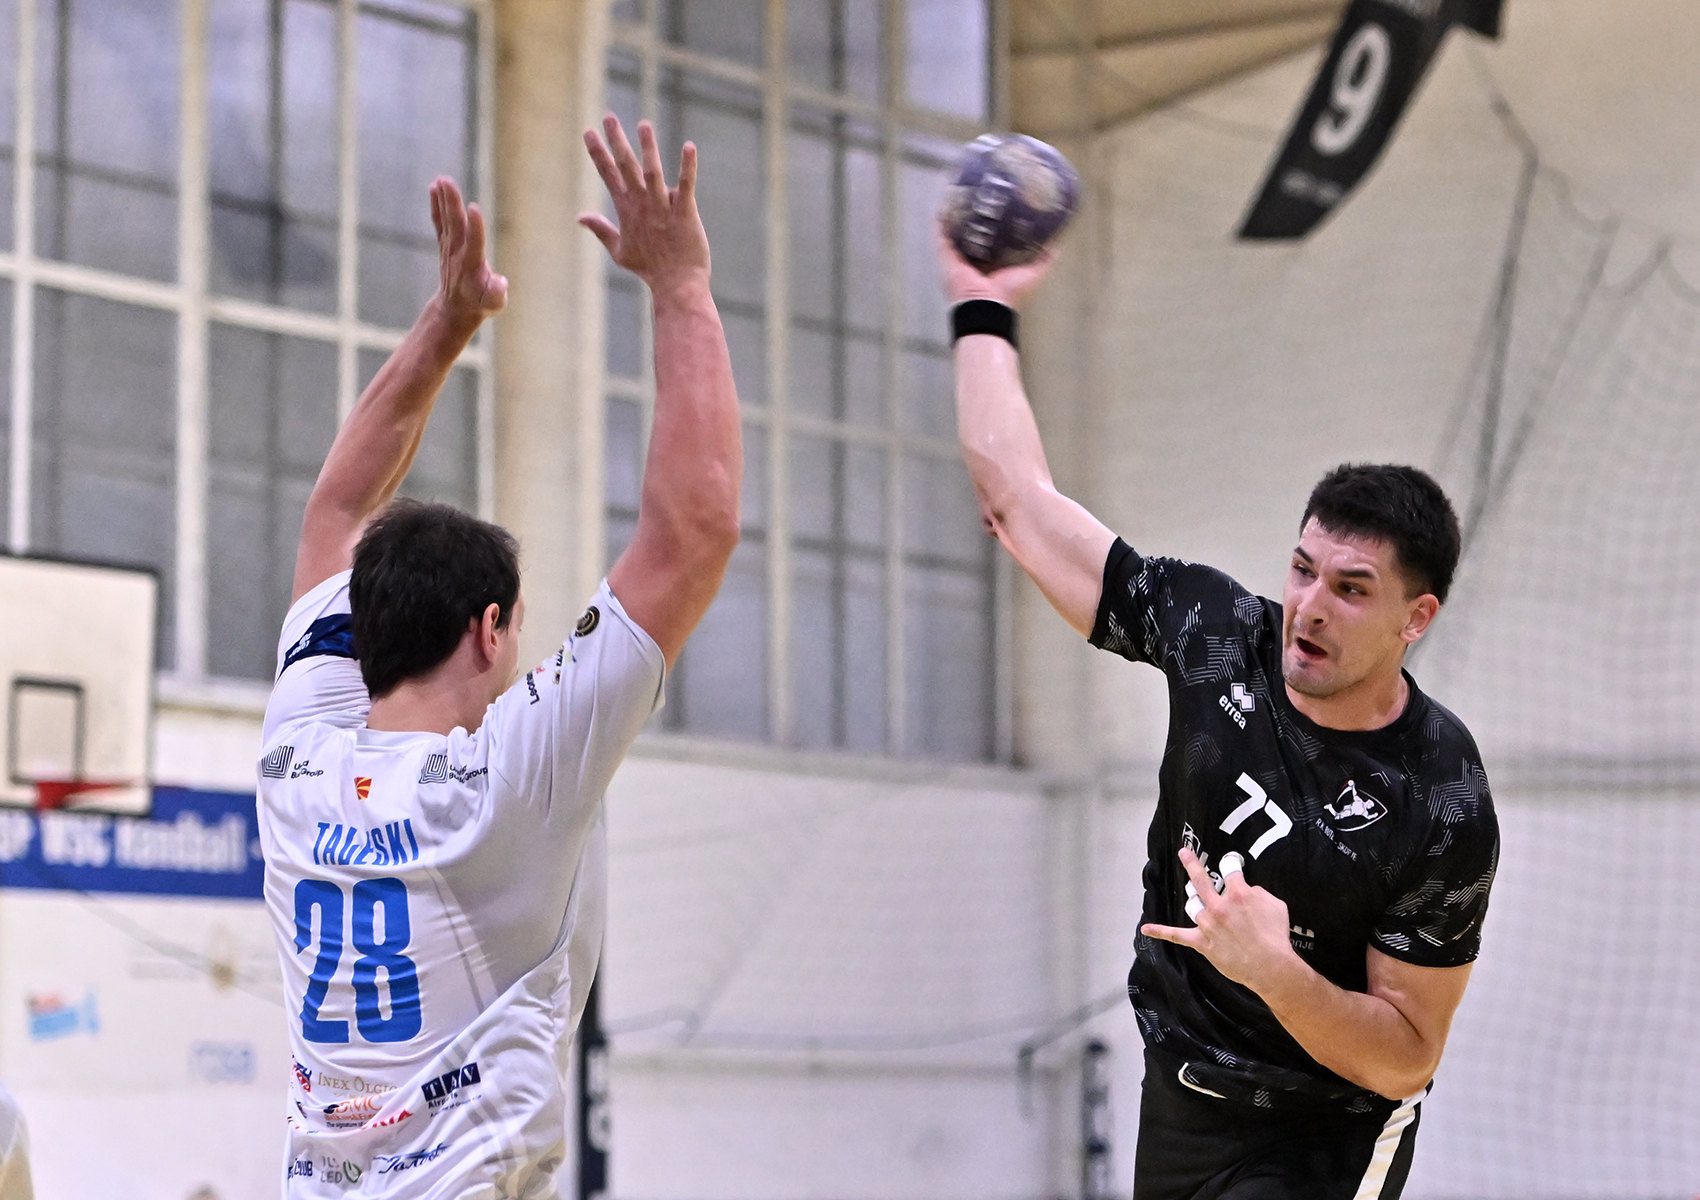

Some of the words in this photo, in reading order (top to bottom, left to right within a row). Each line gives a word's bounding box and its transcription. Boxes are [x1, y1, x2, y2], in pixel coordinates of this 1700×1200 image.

[1310, 21, 1390, 155] 9
[1219, 772, 1293, 860] 77
[293, 876, 423, 1044] 28
[318, 1071, 351, 1091] INEX
[423, 1064, 478, 1098] TAV
[320, 1170, 343, 1184] LED
